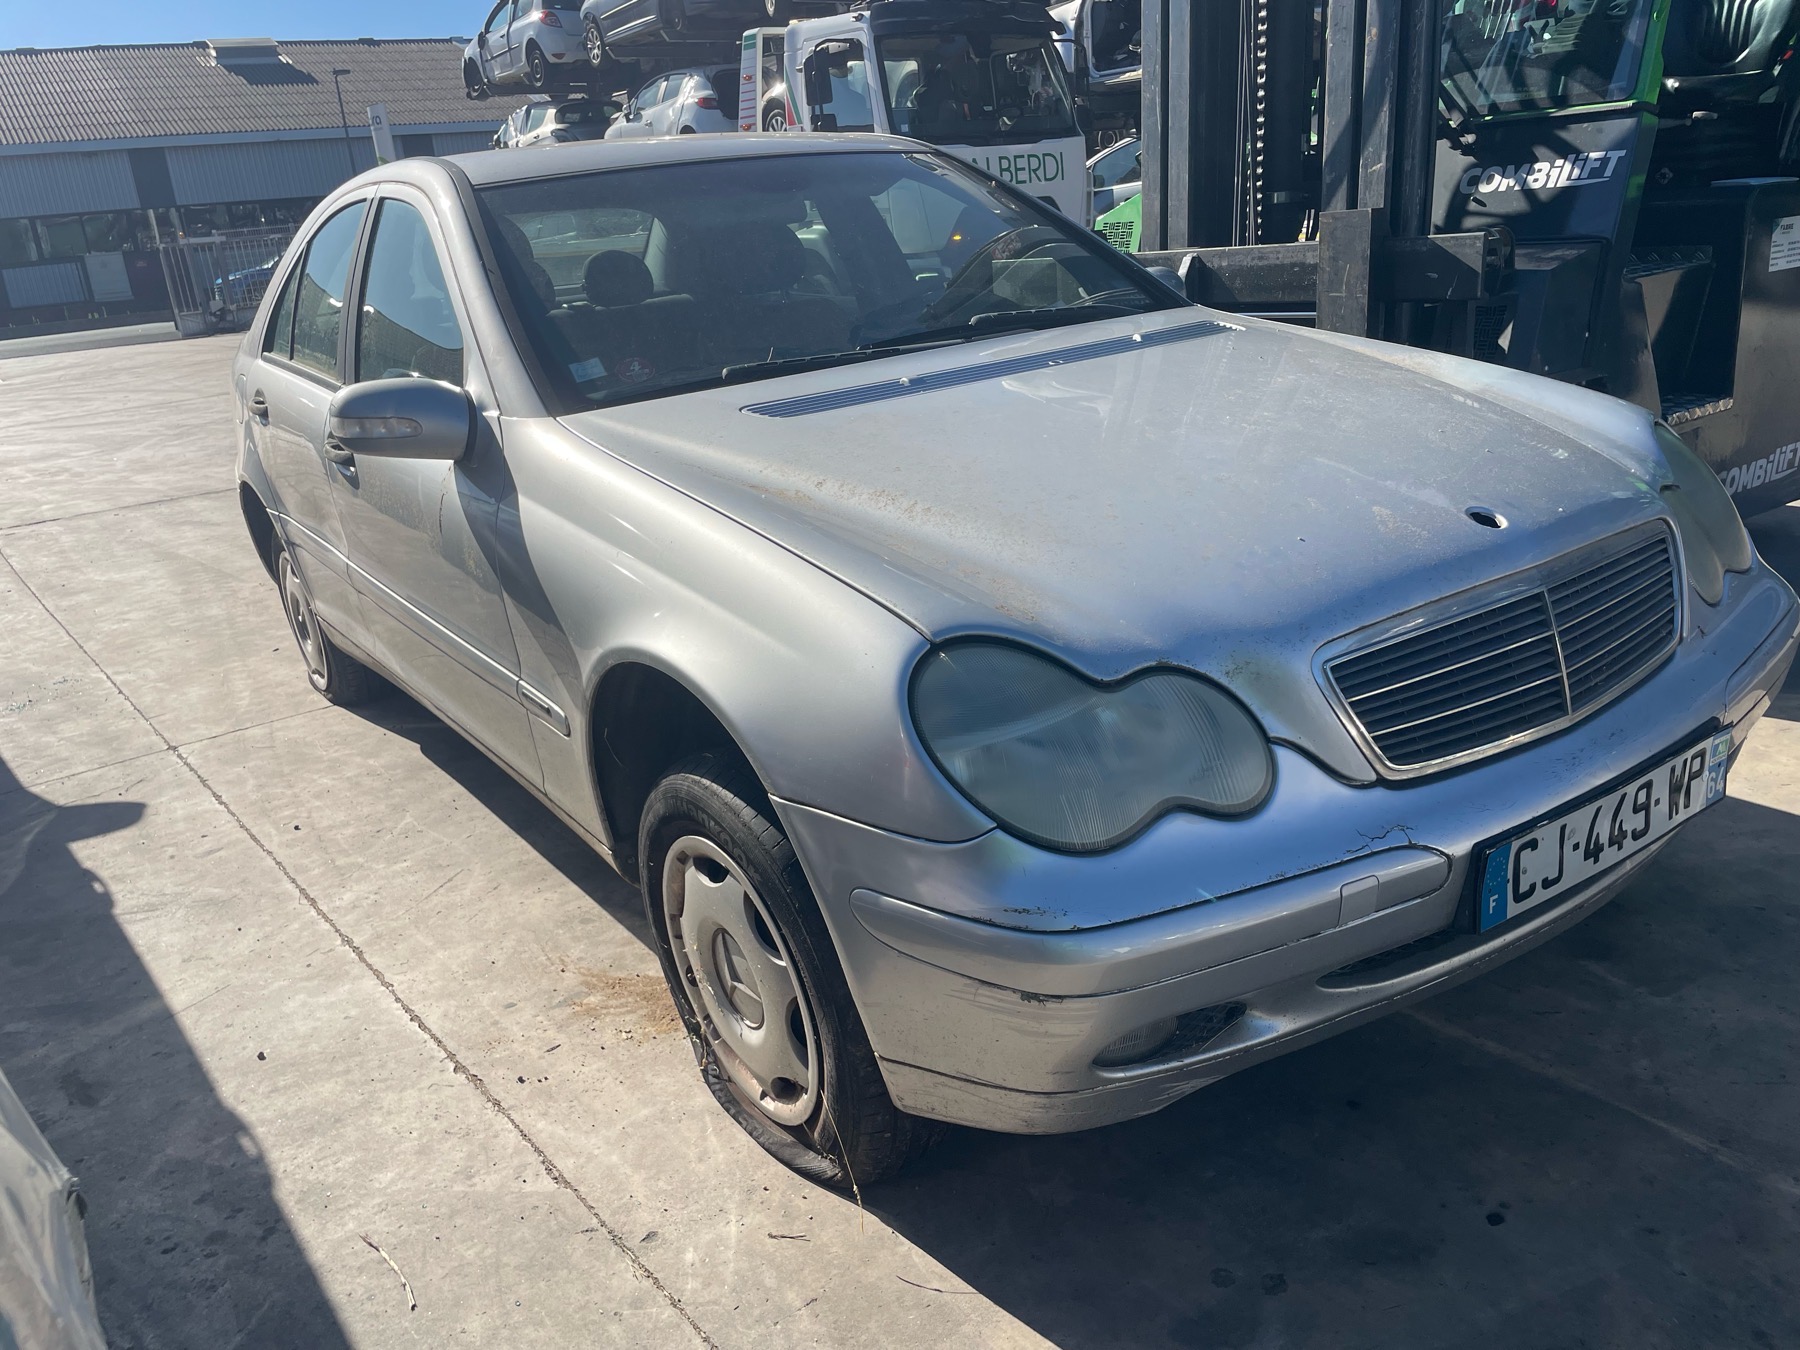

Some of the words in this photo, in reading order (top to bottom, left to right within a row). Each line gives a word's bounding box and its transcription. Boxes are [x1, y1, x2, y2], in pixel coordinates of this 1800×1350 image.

[972, 151, 1065, 185] BERDI
[1706, 766, 1725, 799] 64
[1512, 747, 1707, 904] CJ-449-WP
[1489, 894, 1498, 915] F
